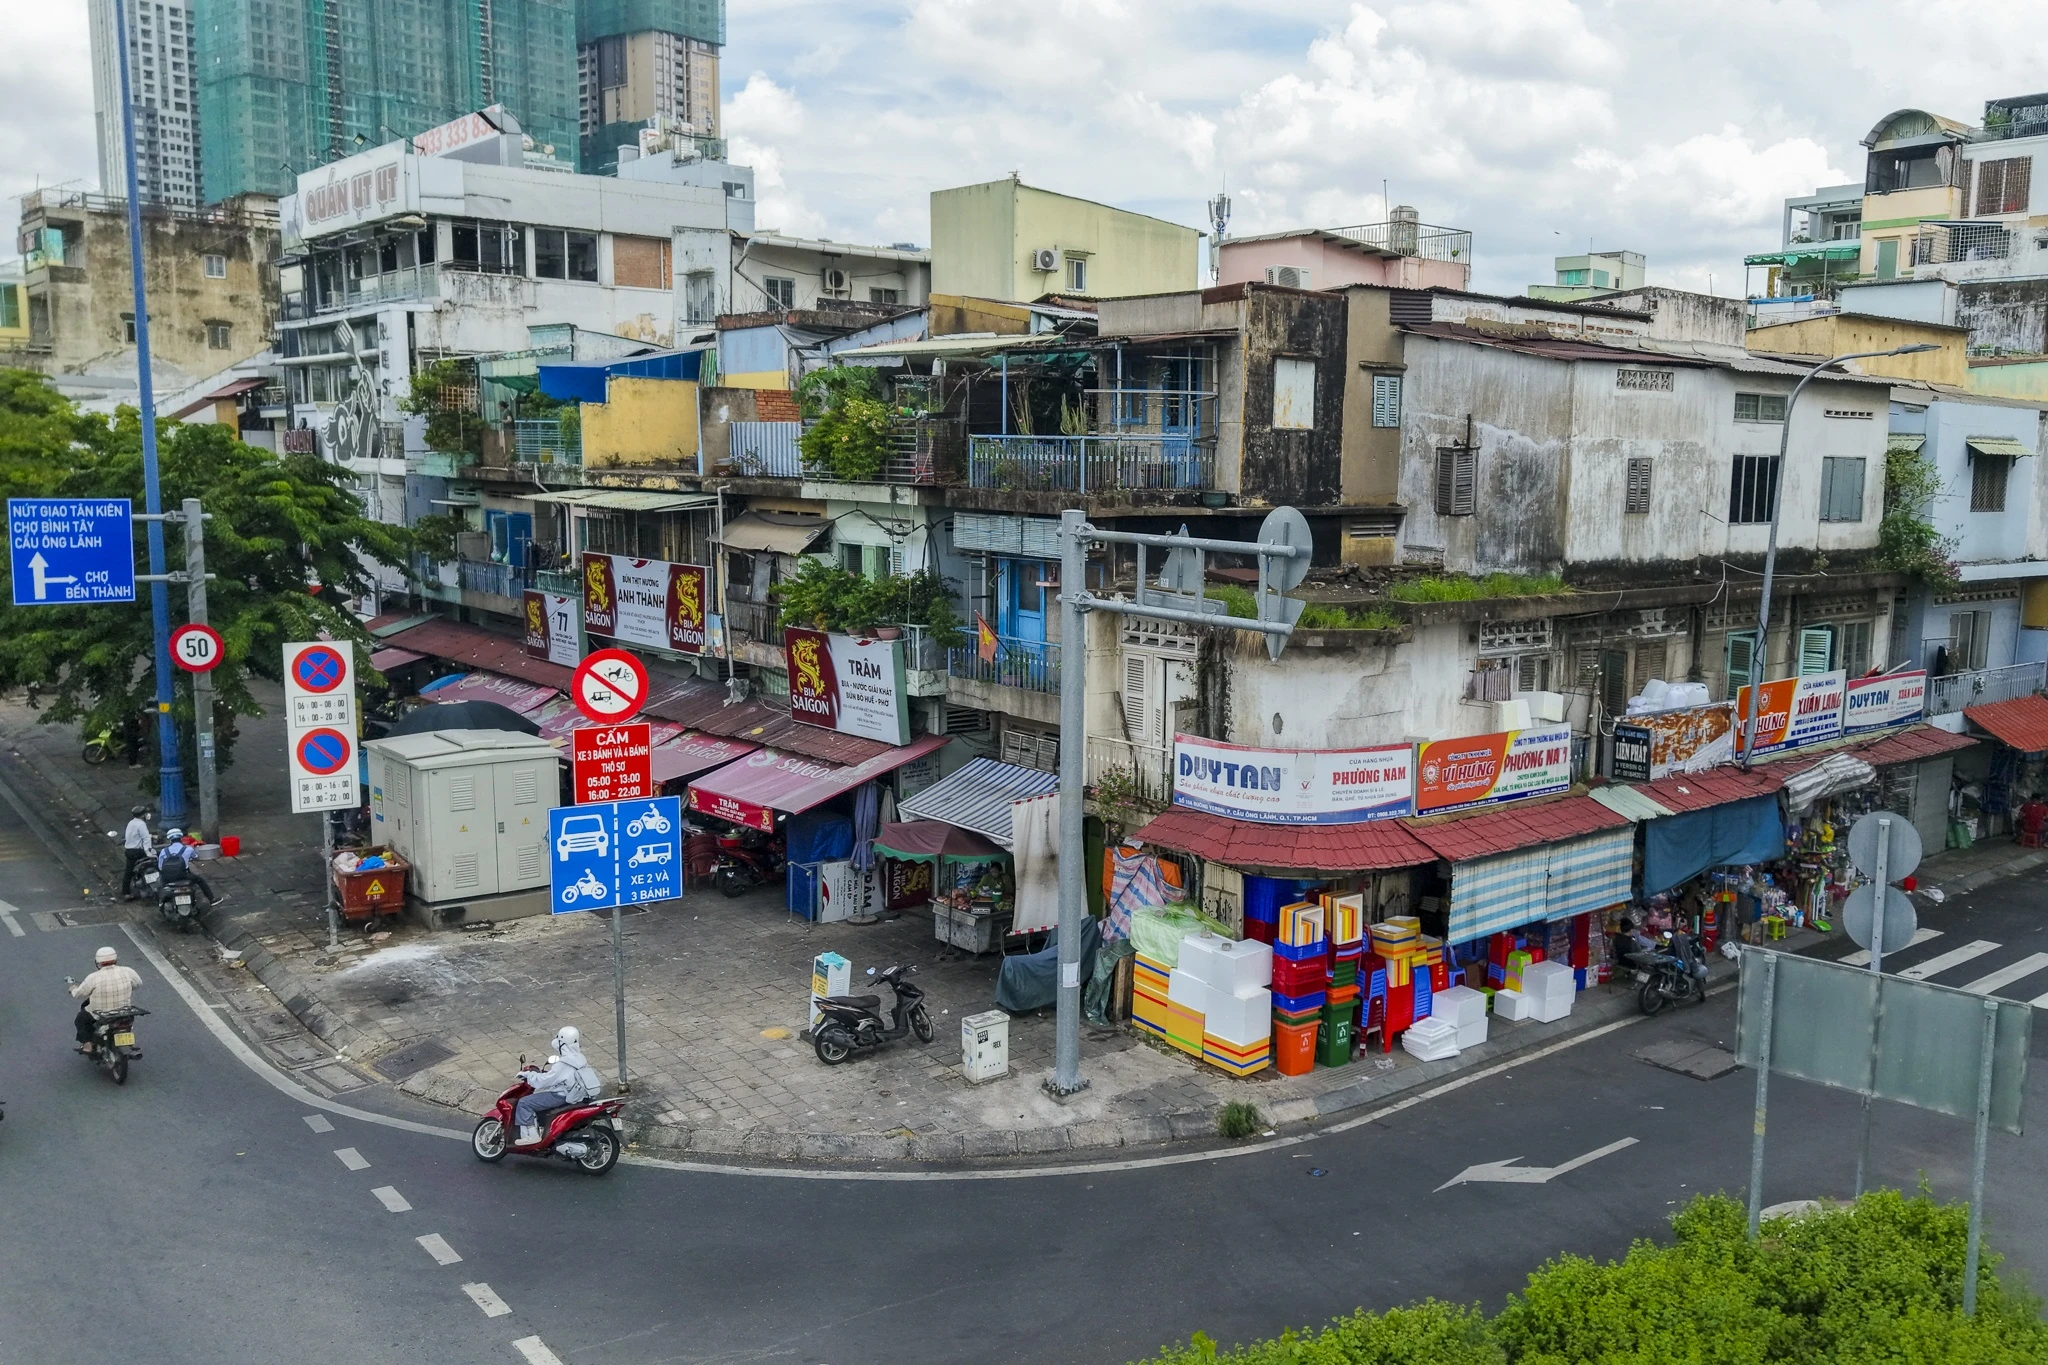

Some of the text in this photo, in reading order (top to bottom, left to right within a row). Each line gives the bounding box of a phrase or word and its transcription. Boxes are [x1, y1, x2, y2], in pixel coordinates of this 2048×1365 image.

[446, 118, 467, 148] 333
[306, 162, 398, 225] QUÁN ỤT ỤT
[13, 503, 122, 517] NÚT GIAO TÂN KIÊN
[14, 518, 94, 535] CHỢ BÌNH TÂY
[15, 533, 102, 549] CẦU ÔNG LÃNH
[85, 570, 108, 584] CHỢ
[622, 574, 659, 588] BÚN THỊT NƯỚNG
[66, 583, 131, 599] BẾN THÀNH
[618, 589, 665, 609] ANH THÀNH
[593, 603, 602, 612] BIA
[557, 612, 568, 632] 77
[585, 610, 611, 628] SAIGON
[683, 619, 693, 628] BIA
[526, 636, 545, 648] SAIGON
[673, 627, 704, 646] SAIGON
[186, 638, 208, 657] 50
[848, 658, 881, 680] TRÂM
[484, 678, 536, 698] SAIGO
[803, 687, 815, 698] BIA
[841, 680, 850, 688] BIA
[852, 682, 867, 692] NƯỚC
[879, 686, 892, 696] KHÁT
[1803, 679, 1836, 690] CỬA HÀNG NHỰA
[1911, 686, 1923, 698] LANG
[792, 695, 829, 715] SAIGON
[846, 691, 856, 700] BÚN
[864, 695, 874, 704] HUẾ
[1797, 693, 1821, 715] XUÂN
[1822, 692, 1842, 712] LANG
[1850, 689, 1889, 710] DUYTAN
[596, 728, 629, 746] CẤM
[577, 744, 648, 761] XE 3 BÁNH VÀ 4 BÁNH
[1616, 737, 1648, 763] LIÊN PHÁT
[601, 760, 626, 773] THÔ SƠ
[777, 758, 830, 779] SAIGO
[1504, 750, 1544, 772] PHƯƠNG
[1180, 753, 1281, 791] DUYTAN
[1332, 766, 1406, 785] PHƯƠNG NAM
[1442, 760, 1496, 782] VĨ HƯNG
[587, 773, 641, 788] 05:00 13:00
[1180, 779, 1192, 788] Sản
[1225, 789, 1241, 798] chất
[588, 785, 641, 801] 16:00 22:00
[719, 798, 739, 810] TRÂM
[1232, 809, 1244, 817] CẦU
[1245, 811, 1258, 819] ÔNG
[631, 870, 669, 886] XE 2 VÀ
[893, 863, 902, 900] SAIGON
[631, 884, 670, 901] 3 BÁNH
